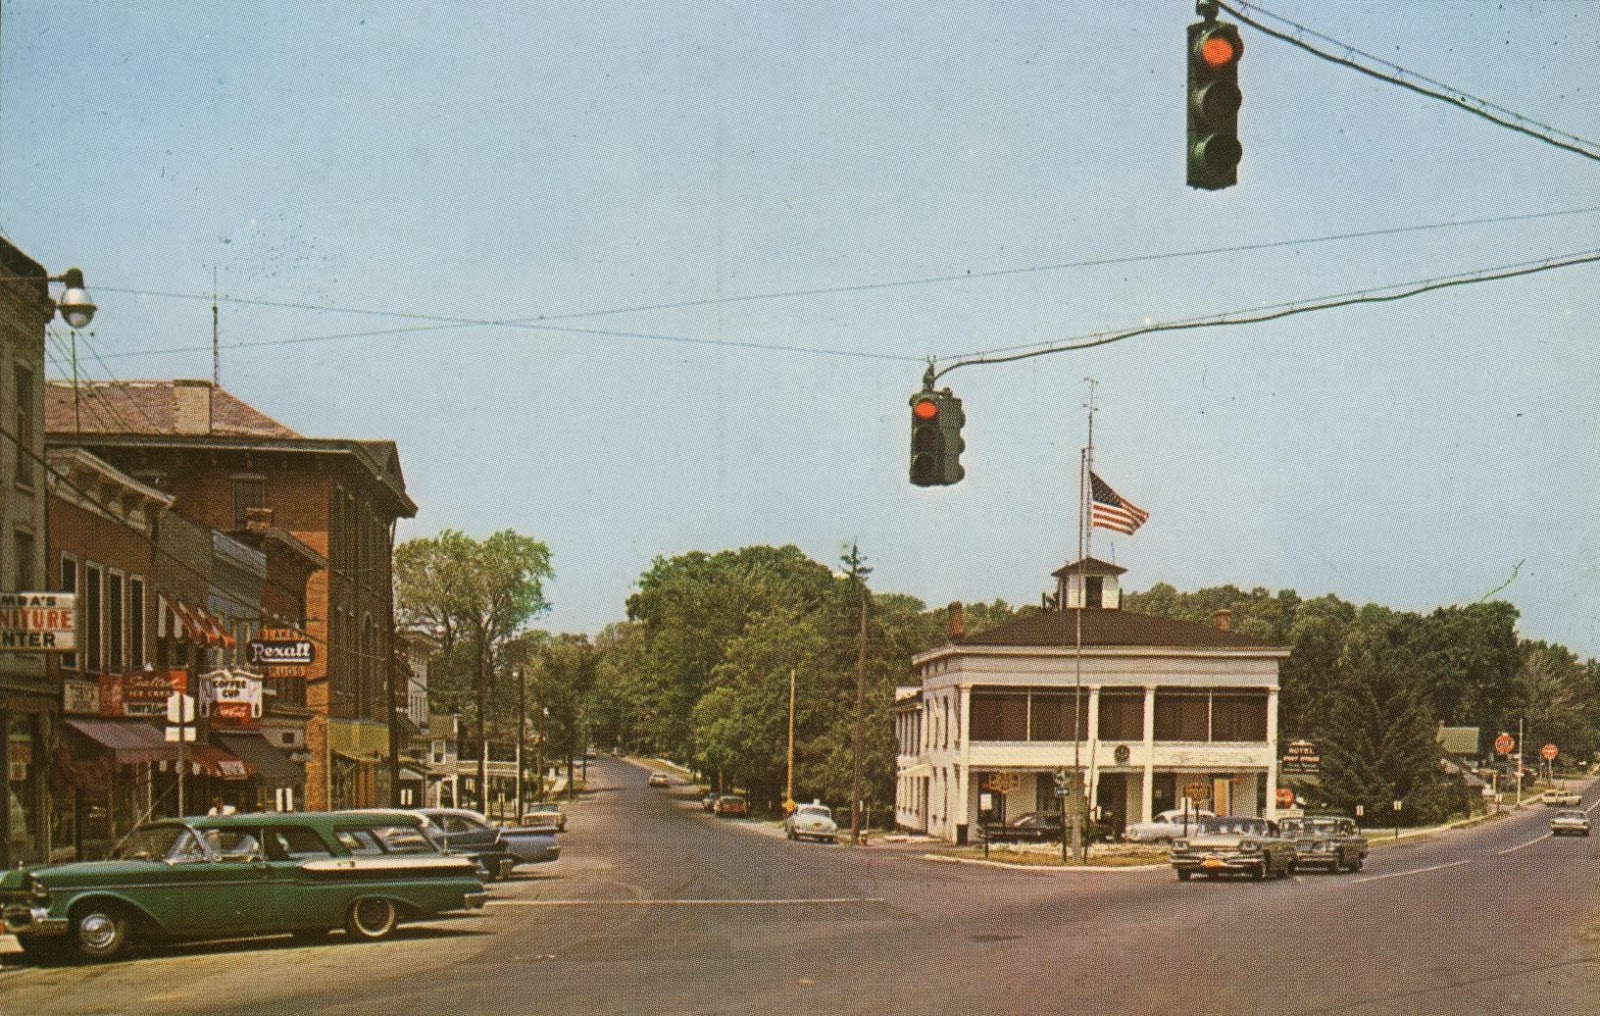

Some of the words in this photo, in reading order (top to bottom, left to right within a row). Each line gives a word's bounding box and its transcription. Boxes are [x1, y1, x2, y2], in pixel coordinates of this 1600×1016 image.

[2, 632, 55, 647] NTER
[251, 642, 311, 663] Rexall
[213, 680, 247, 689] COFFEE
[222, 689, 240, 698] CUP
